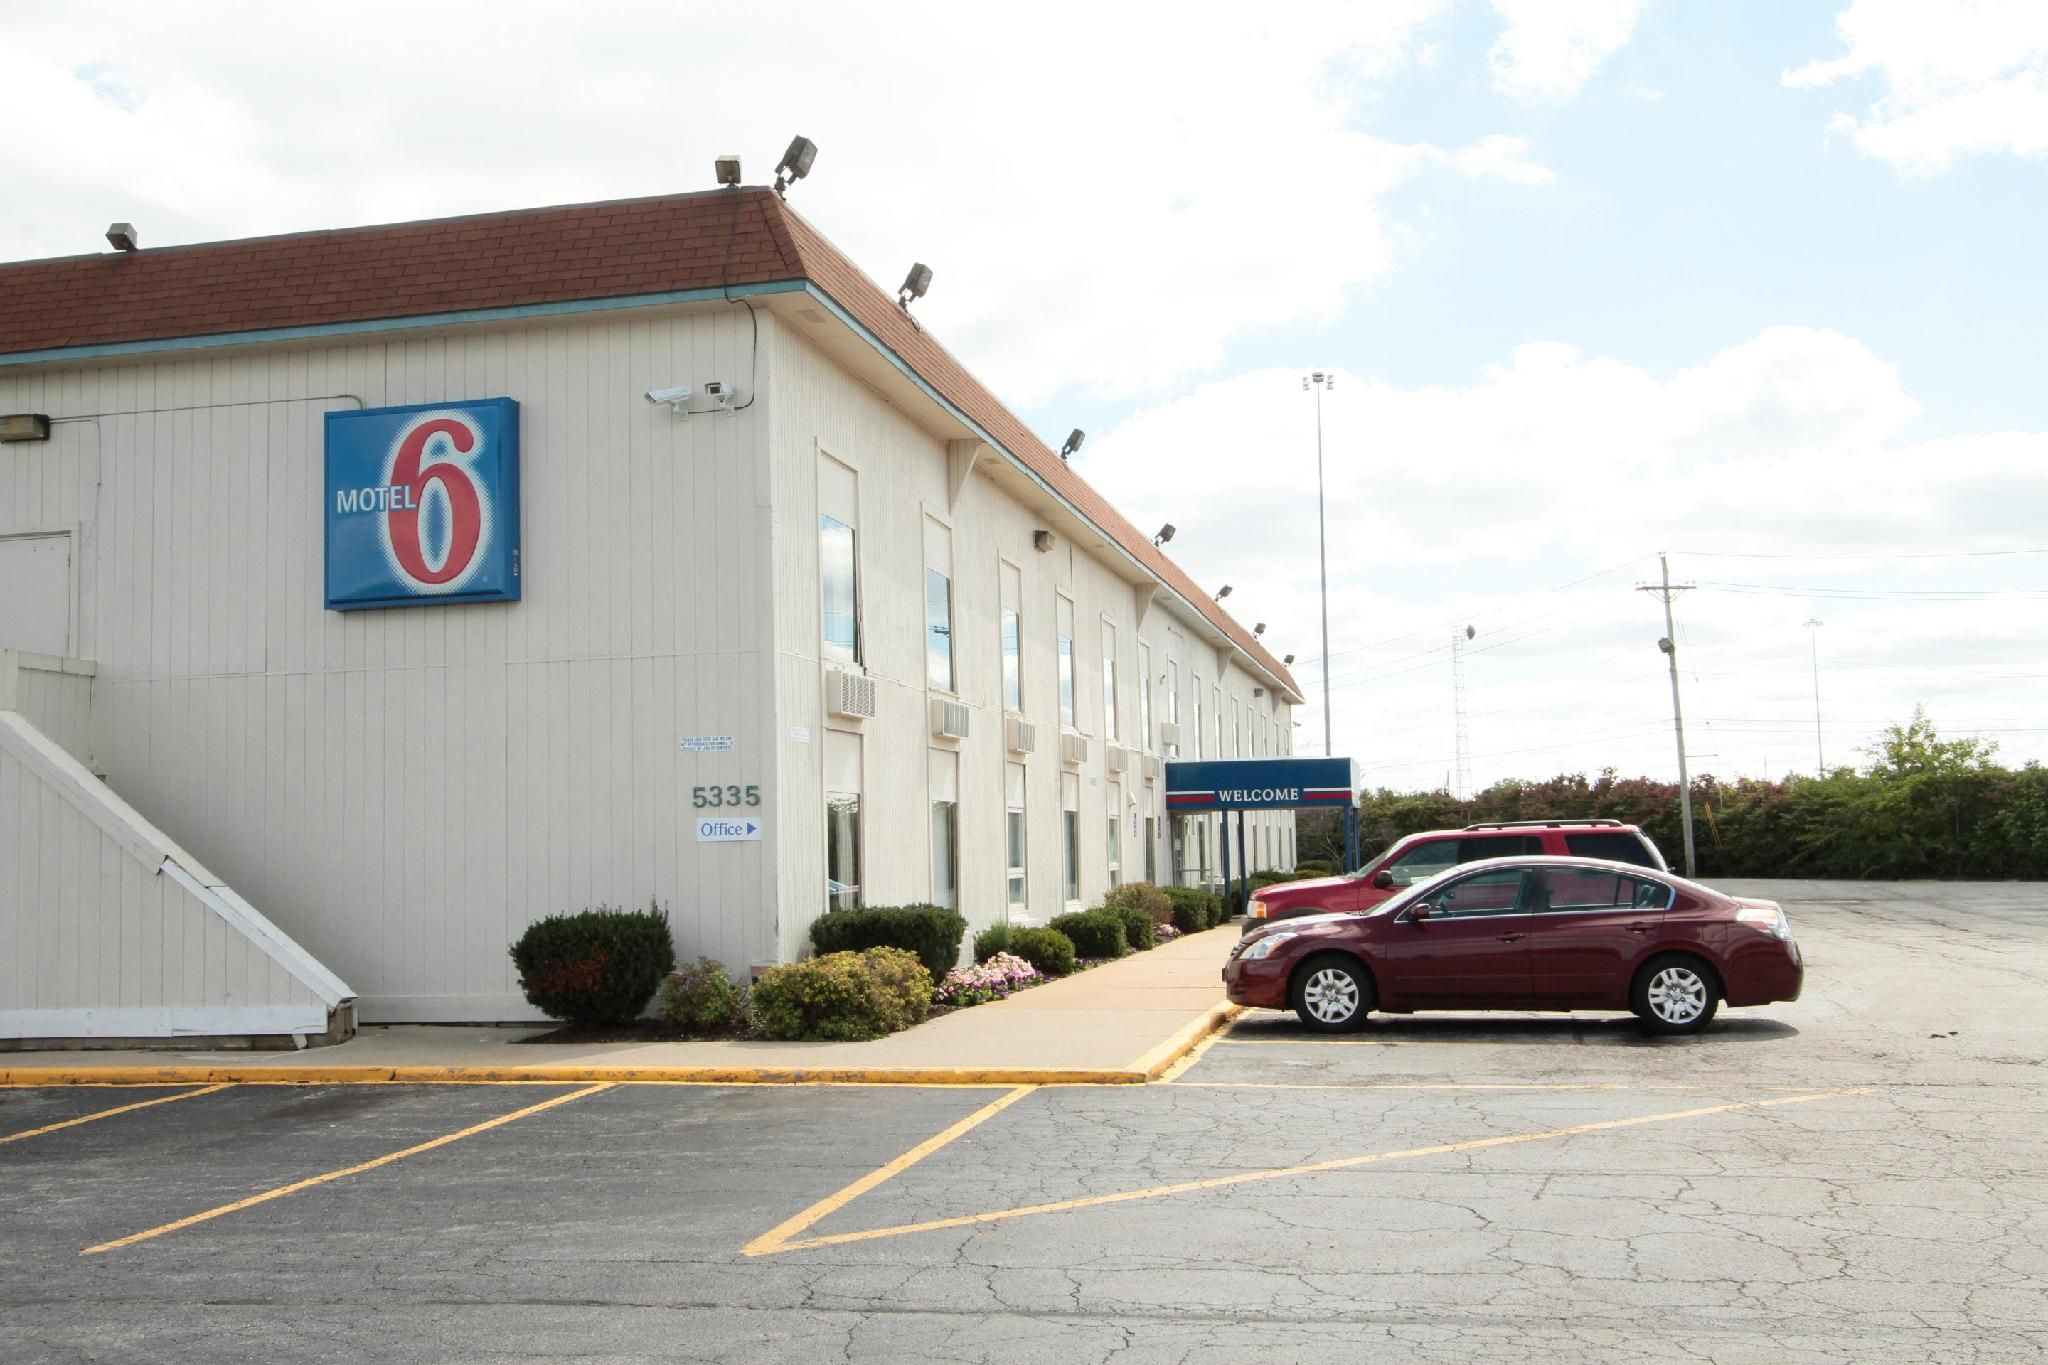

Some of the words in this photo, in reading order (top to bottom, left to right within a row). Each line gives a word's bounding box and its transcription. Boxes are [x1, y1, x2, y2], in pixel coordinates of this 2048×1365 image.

[336, 484, 417, 514] MOTEL
[387, 418, 482, 585] 6
[692, 785, 761, 808] 5335
[1219, 788, 1300, 802] WELCOME
[701, 822, 743, 836] Office
